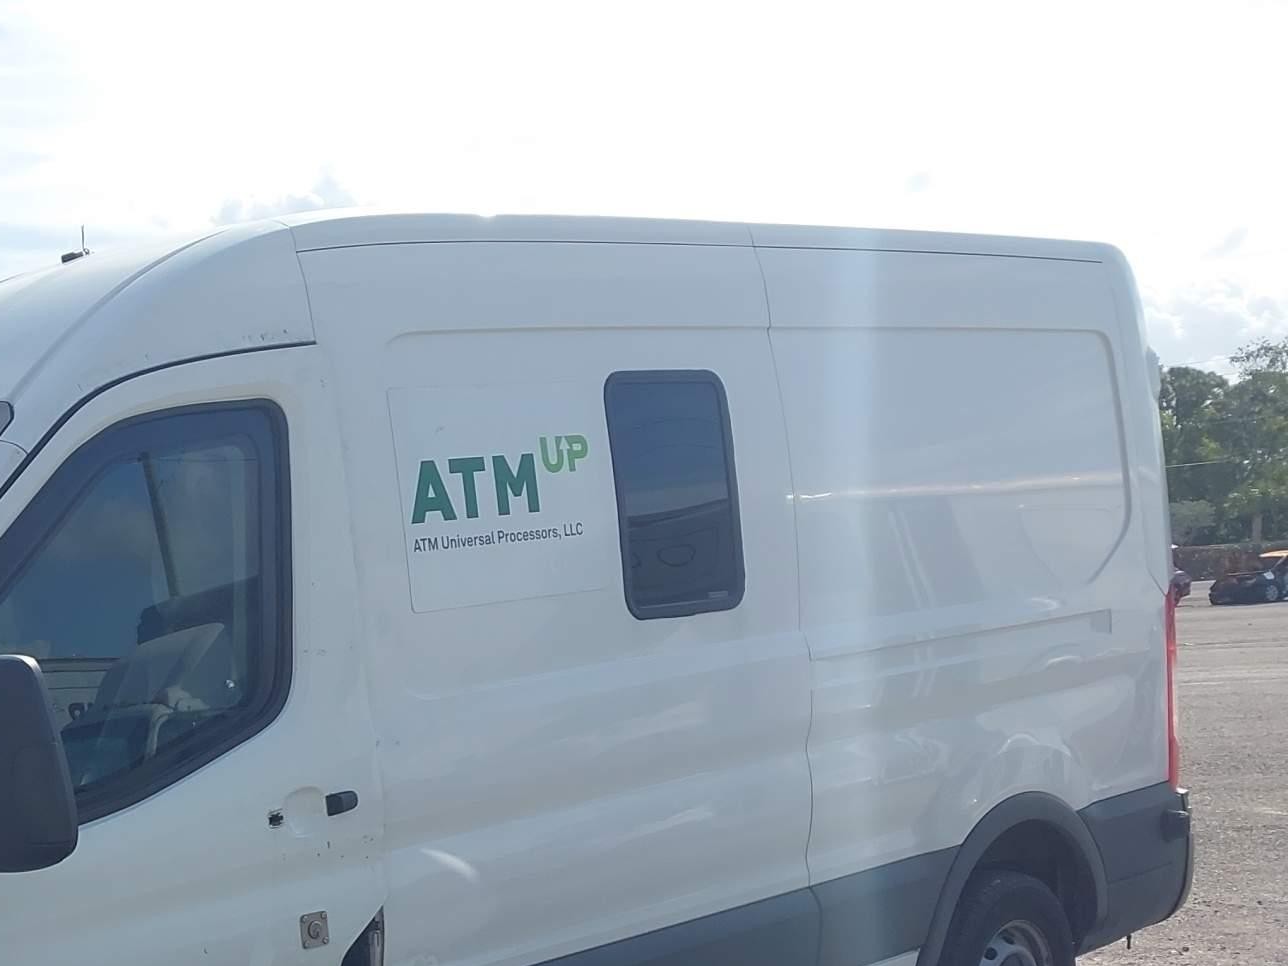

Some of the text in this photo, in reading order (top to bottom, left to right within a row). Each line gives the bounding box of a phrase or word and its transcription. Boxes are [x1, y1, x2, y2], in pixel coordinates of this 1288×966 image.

[411, 434, 589, 524] ATM UP
[413, 522, 584, 553] ATM Universal Processors, LLC
